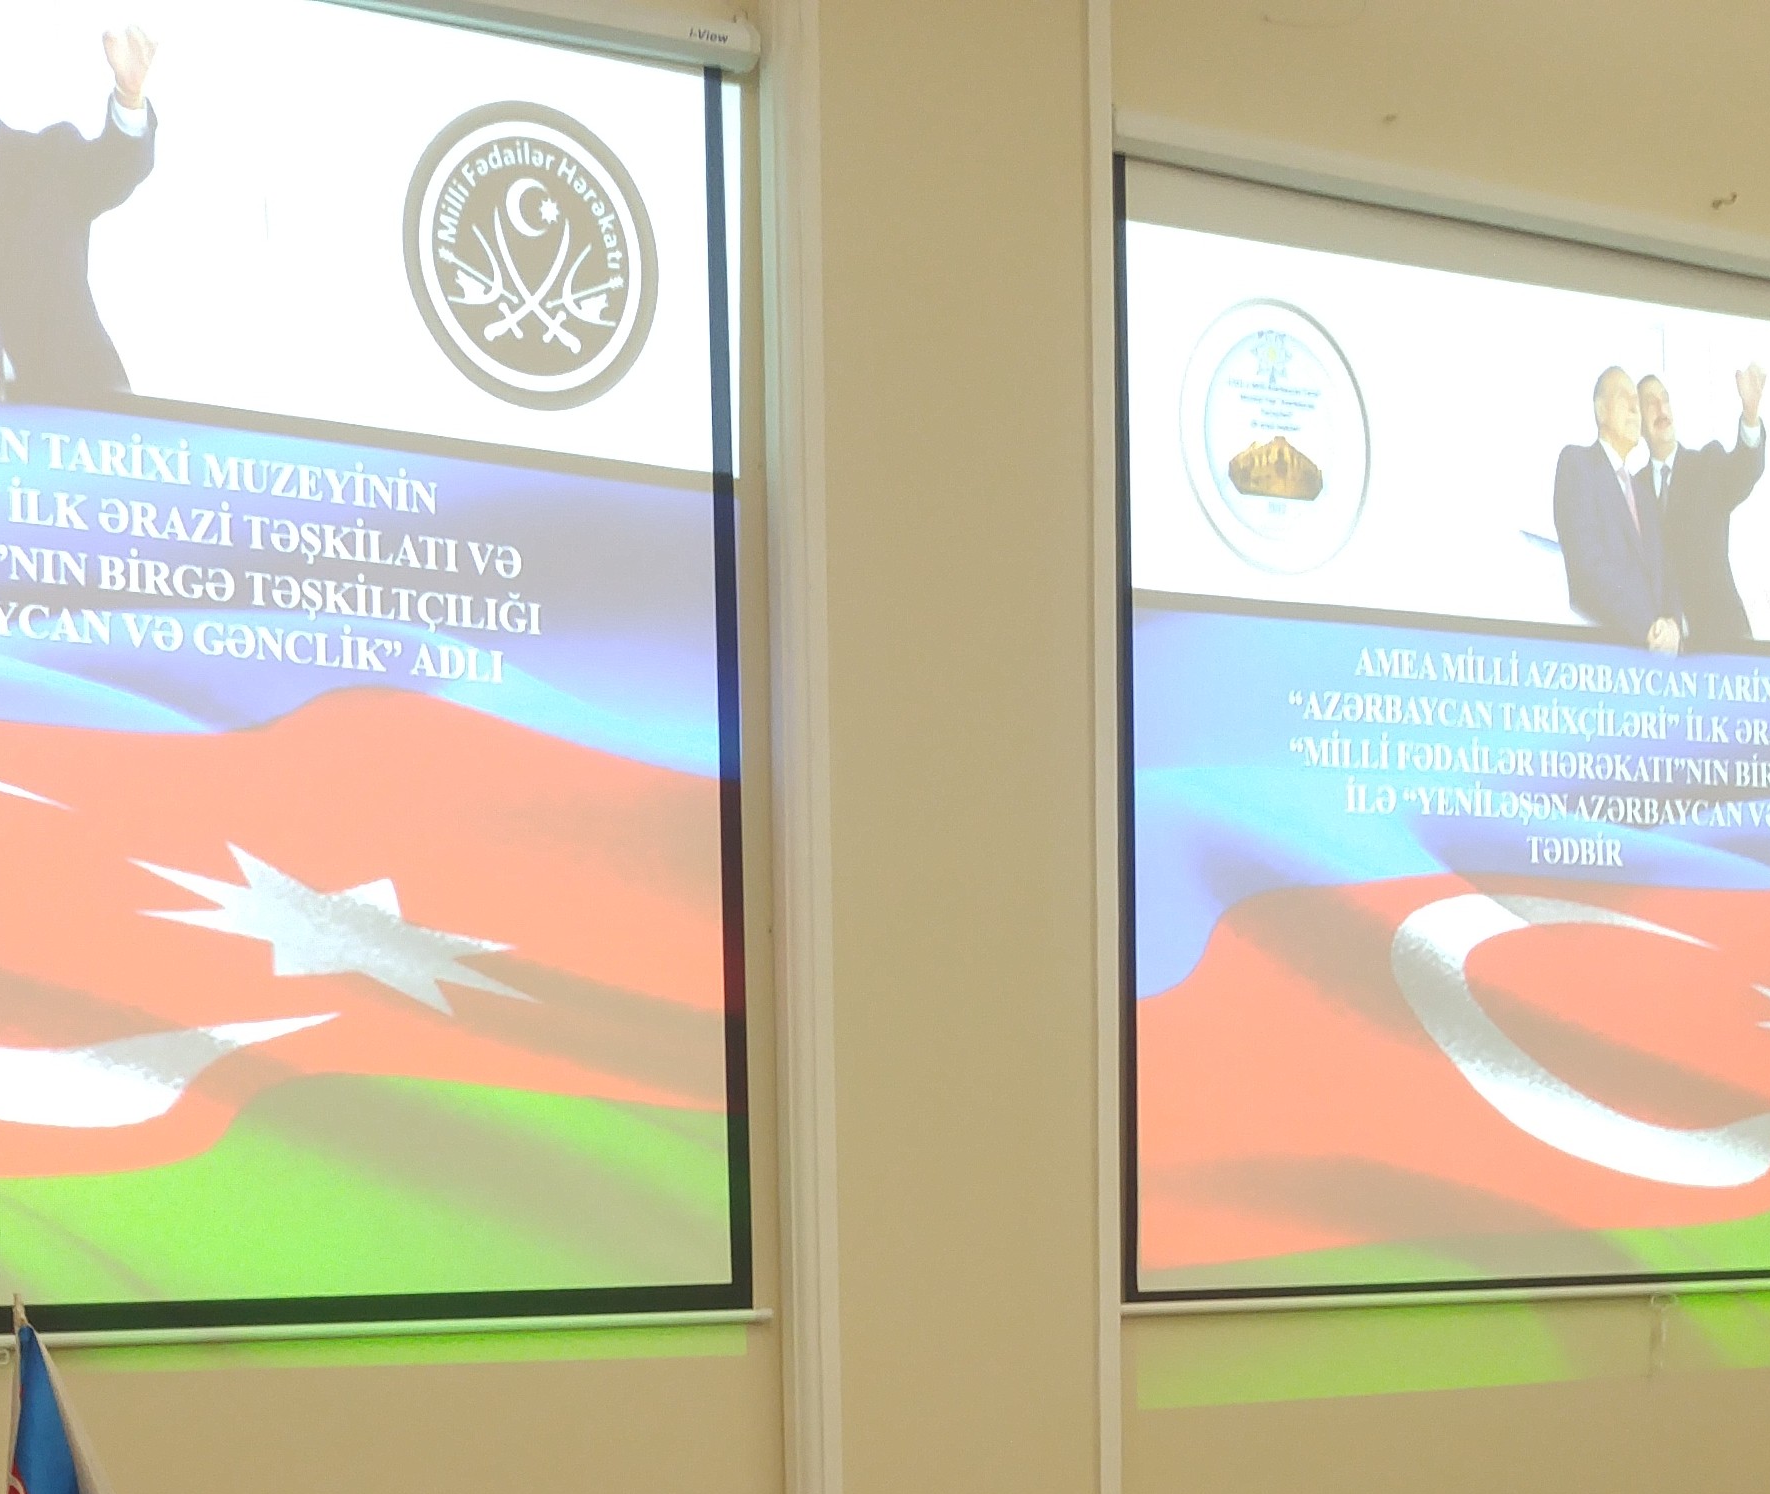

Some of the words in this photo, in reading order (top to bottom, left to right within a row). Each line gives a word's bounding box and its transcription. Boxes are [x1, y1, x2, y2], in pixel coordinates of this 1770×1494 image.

[436, 179, 470, 244] Milli
[42, 433, 191, 484] TARİXİ
[203, 453, 436, 514] MUZEYİNİN
[8, 476, 89, 530] İLK
[98, 499, 233, 546] ƏRAZİ
[243, 515, 458, 576] TƏŞKİLATI
[468, 542, 521, 578] VƏ
[98, 548, 235, 601] BİRGƏ
[246, 560, 541, 635] TƏŞKİLTÇILIĞI
[121, 613, 183, 651] VƏ
[193, 613, 401, 672] GƏNCLİK”
[411, 644, 503, 684] ADLI
[1355, 647, 1438, 680] AMEA
[1442, 646, 1519, 686] MİLLİ
[1525, 661, 1697, 697] AZƏRBAYCAN
[1290, 729, 1390, 770] “MİLLİ
[1398, 736, 1534, 776] FƏDAİLƏR
[1686, 707, 1730, 743] İLK
[1345, 775, 1397, 815] İLƏ
[1403, 781, 1568, 825] “YENİLƏŞƏN
[1573, 795, 1743, 827] AZƏRBAYCAN
[1526, 833, 1622, 866] TƏDBİR
